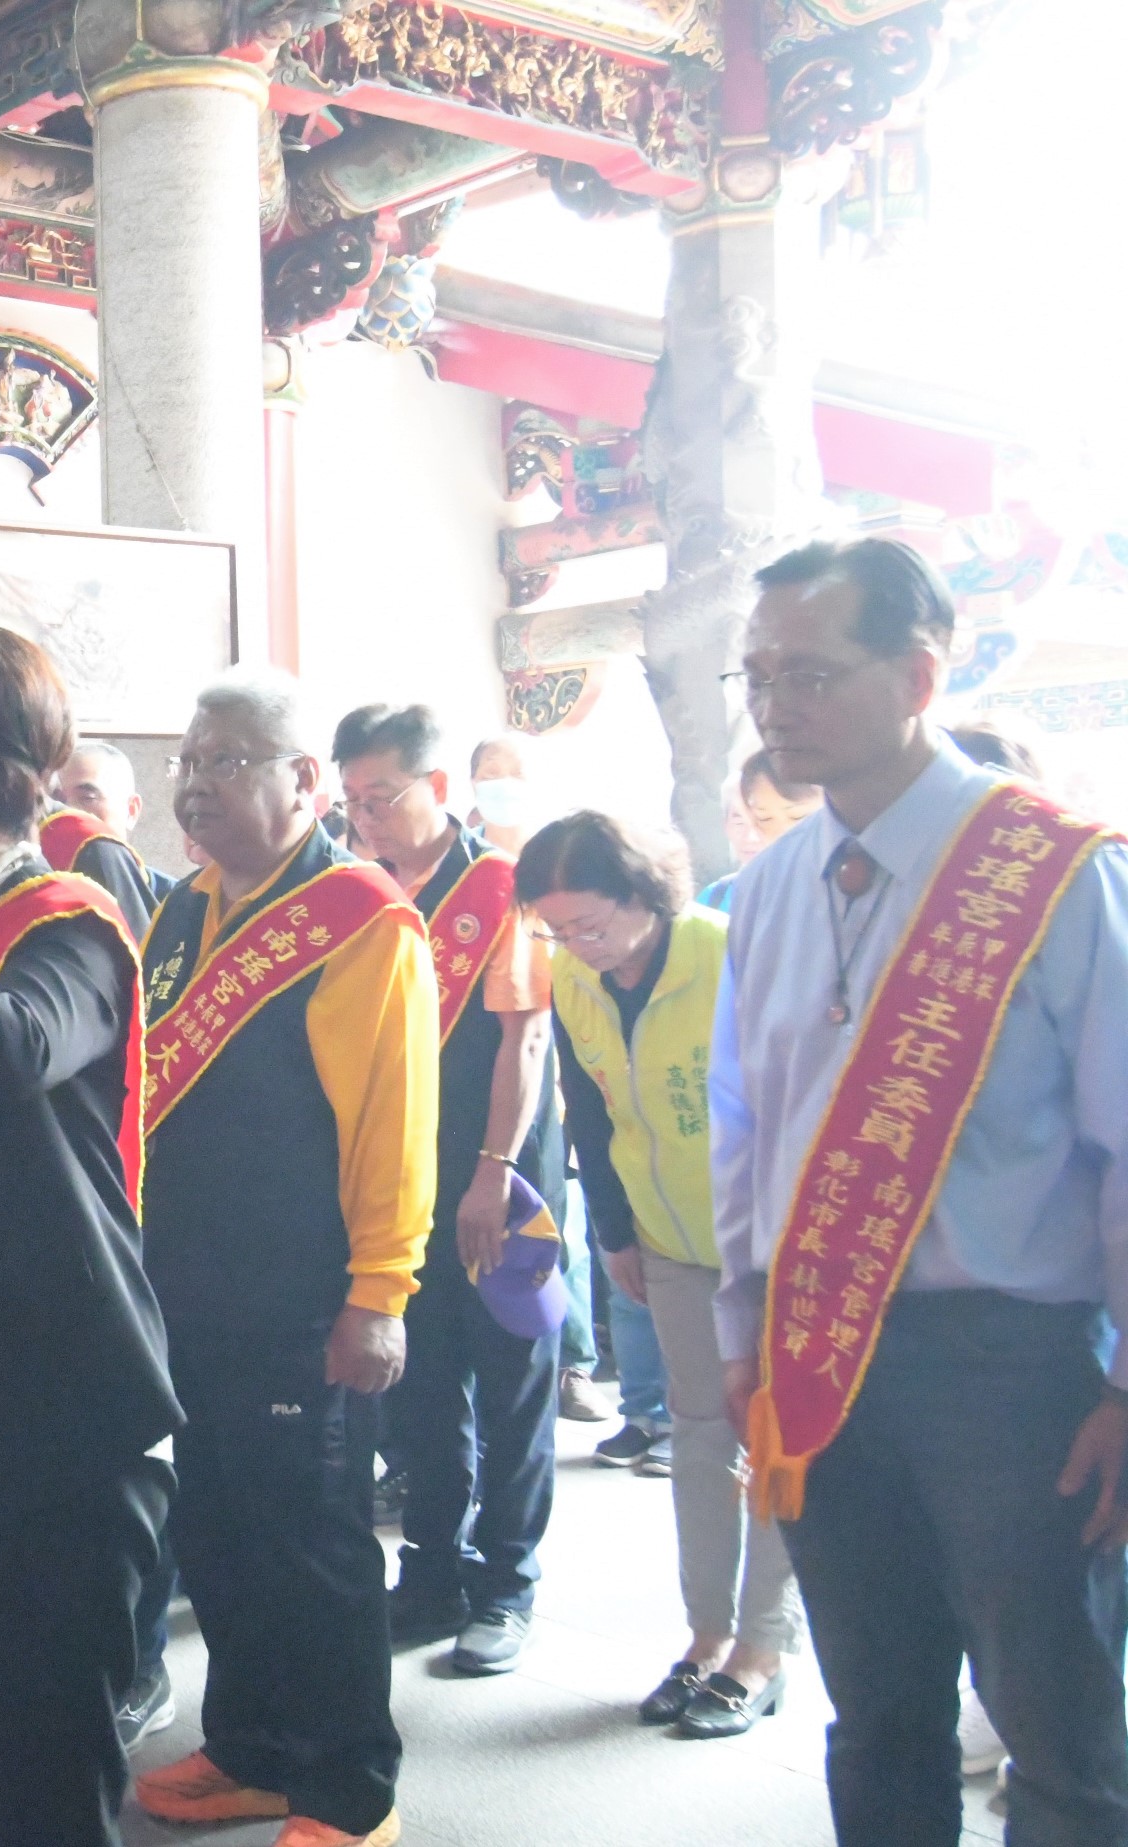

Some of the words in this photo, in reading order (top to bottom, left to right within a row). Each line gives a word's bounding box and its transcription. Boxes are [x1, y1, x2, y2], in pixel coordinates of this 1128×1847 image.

[955, 823, 1055, 930] 南瑤宮
[212, 927, 298, 1005] 南瑤宮
[850, 990, 962, 1163] 主任委員
[814, 1173, 914, 1391] 南瑤宮管理人
[271, 1403, 302, 1416] FILA
